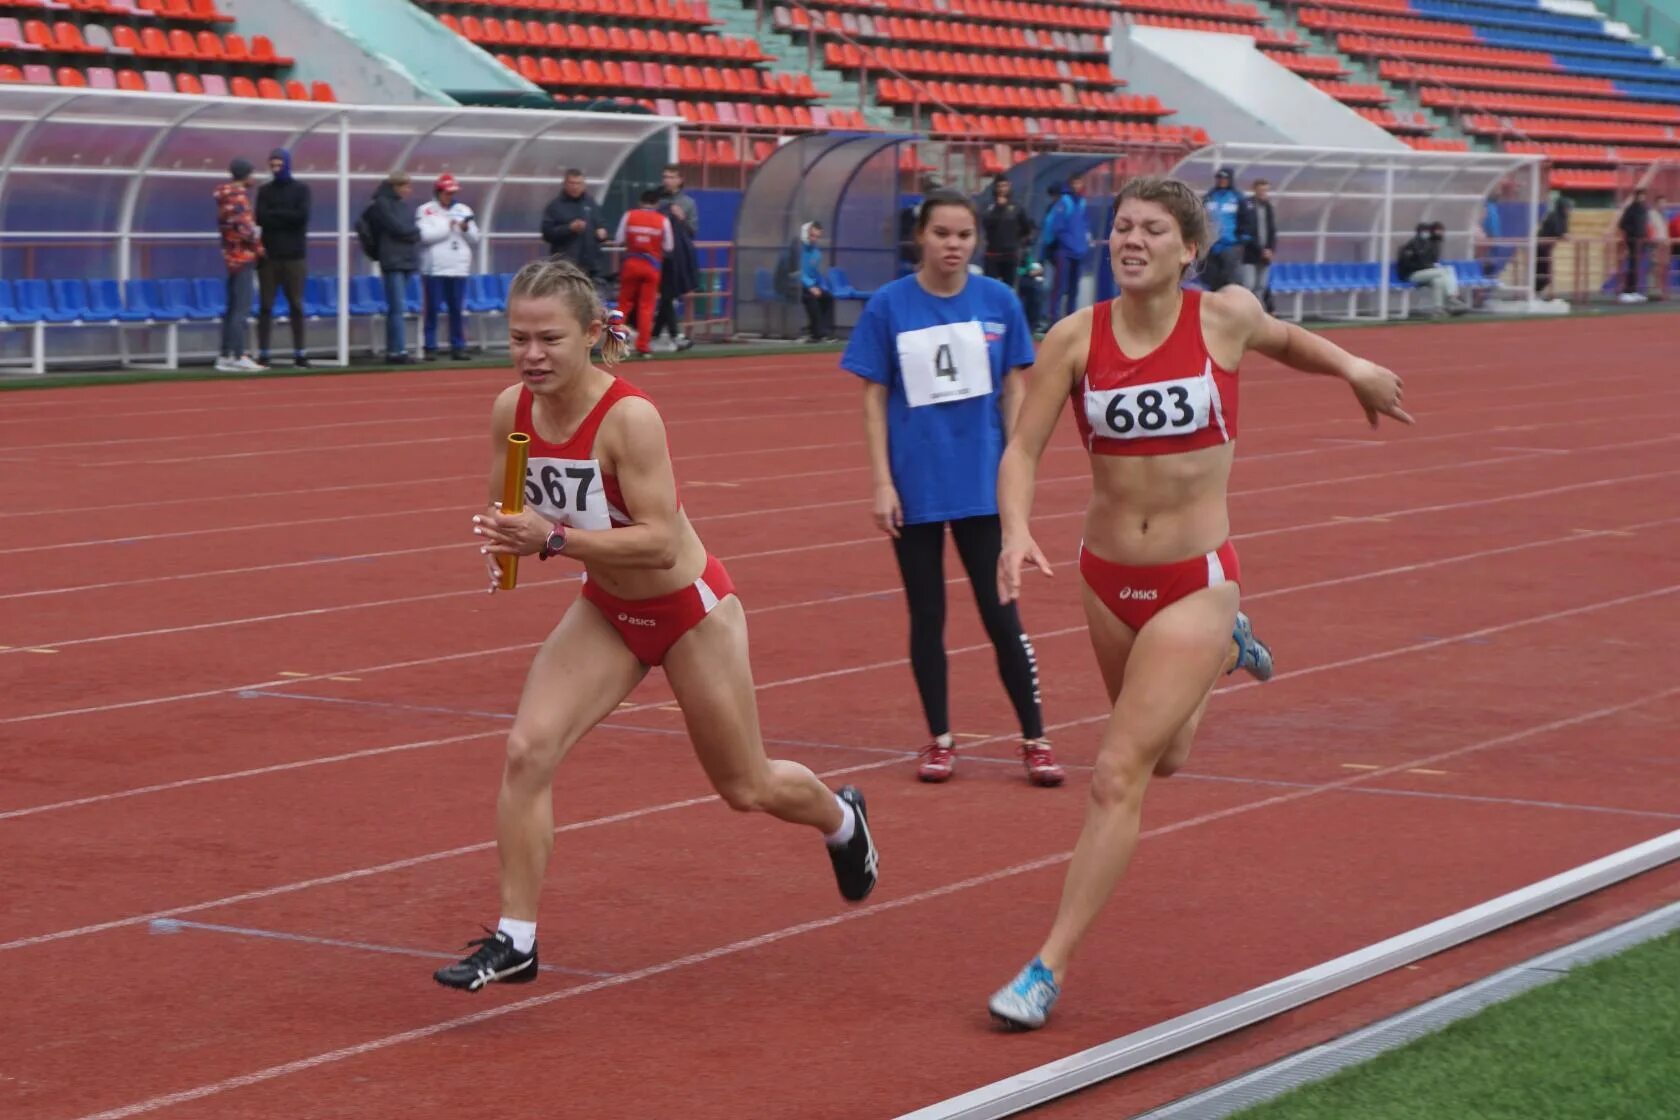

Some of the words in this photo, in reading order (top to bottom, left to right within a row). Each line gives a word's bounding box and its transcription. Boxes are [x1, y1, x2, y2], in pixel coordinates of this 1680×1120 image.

[934, 344, 959, 382] 4
[1105, 386, 1195, 433] 683
[1131, 589, 1158, 600] asics
[628, 616, 657, 627] asics
